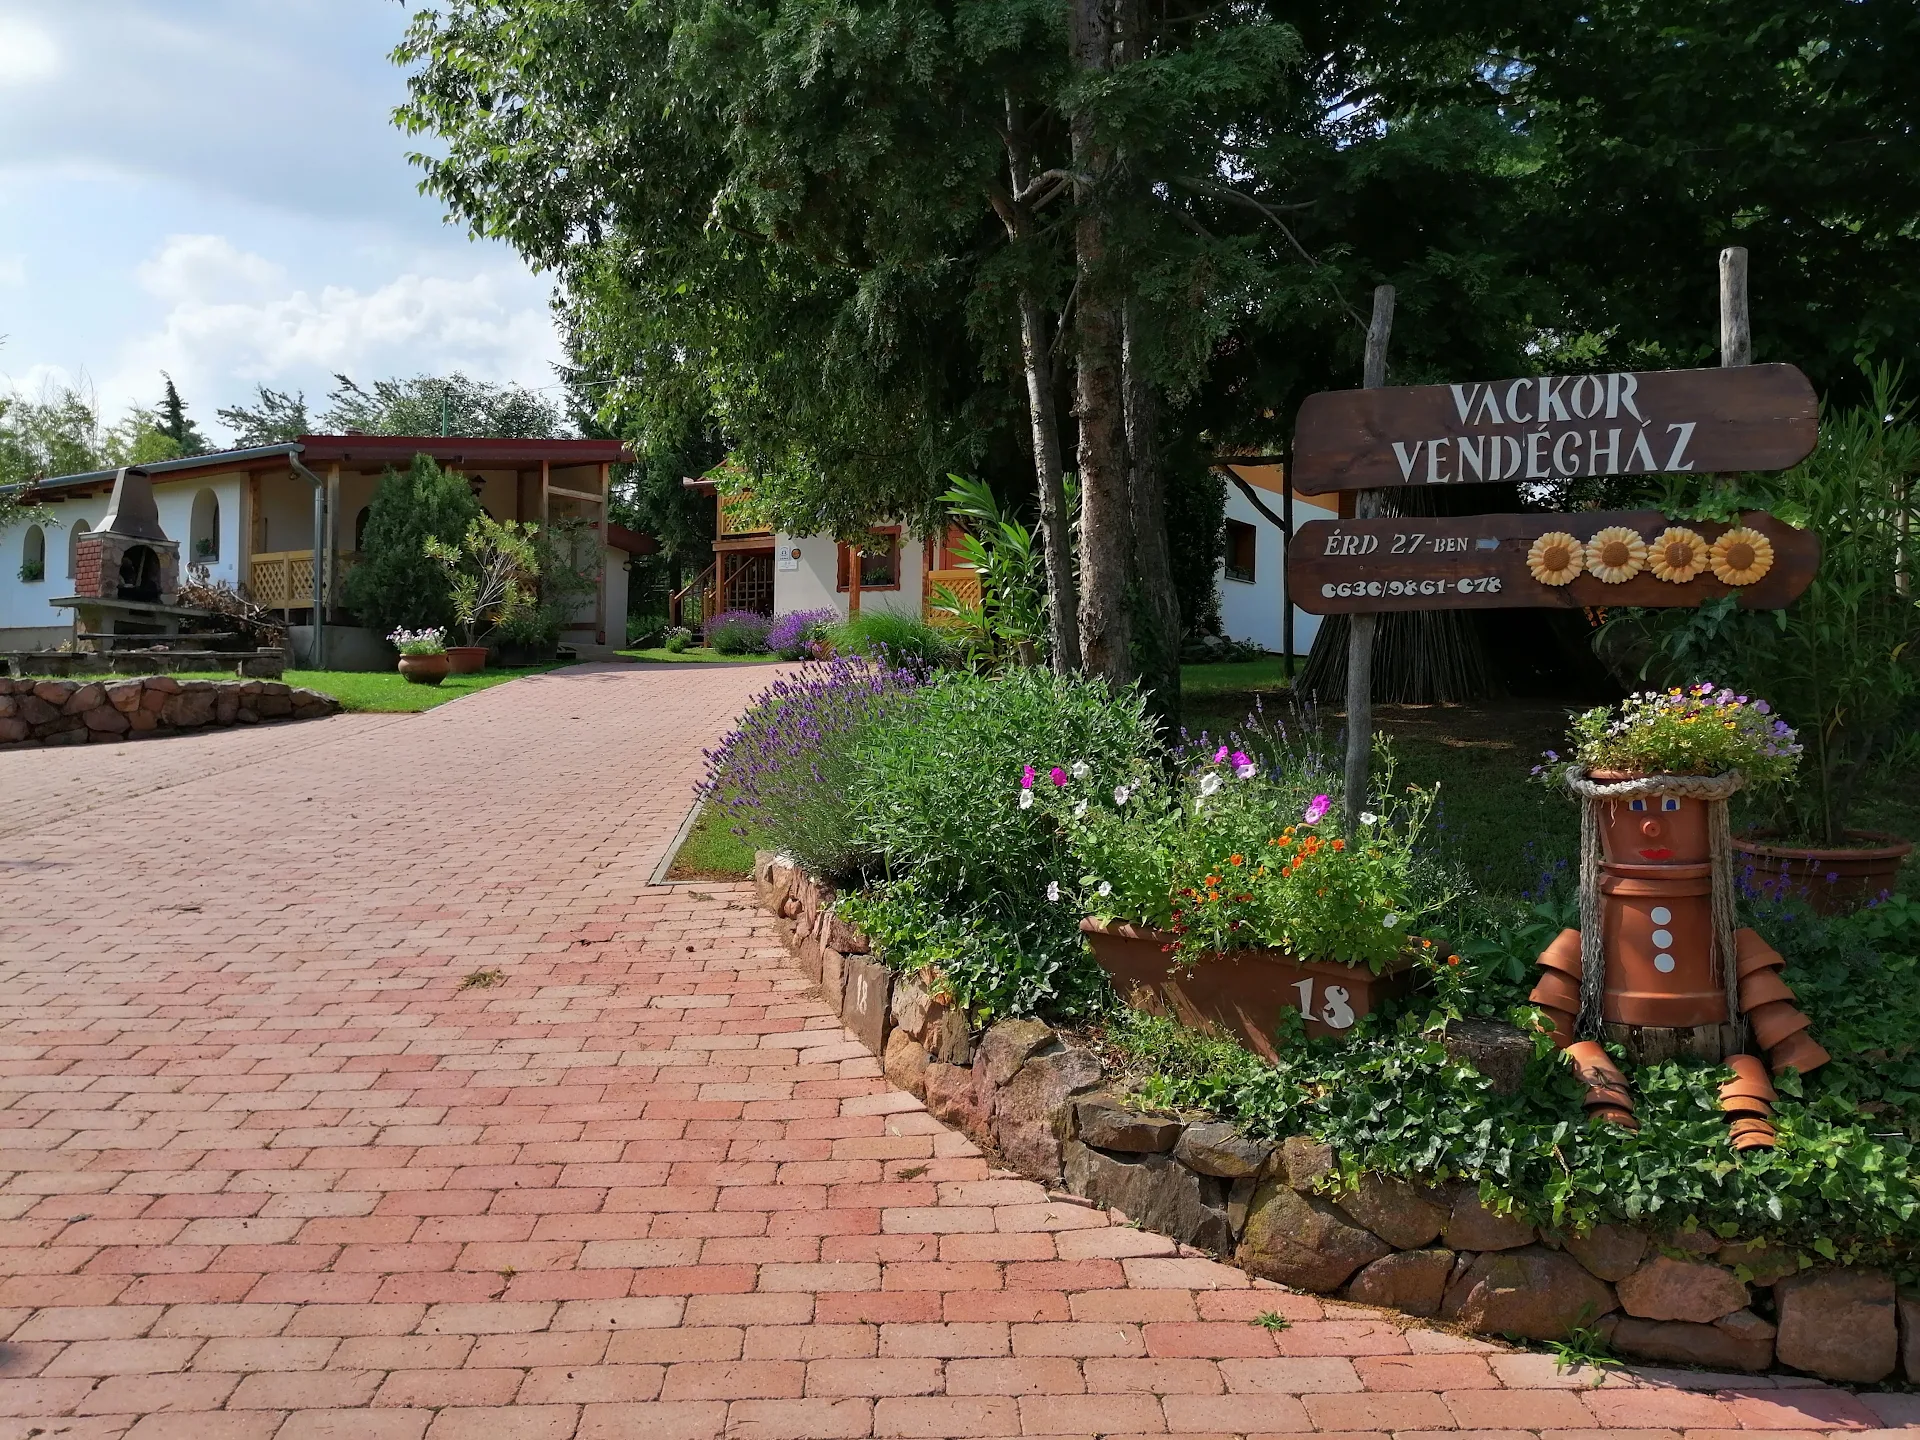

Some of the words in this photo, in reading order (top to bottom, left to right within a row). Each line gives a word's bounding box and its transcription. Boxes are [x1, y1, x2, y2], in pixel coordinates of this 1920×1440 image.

[1450, 373, 1643, 426] VACKOR
[1391, 420, 1697, 483] VENDÉGHÁZ
[1323, 528, 1379, 556] ÉRD
[1390, 533, 1469, 553] 27-BEN
[1290, 977, 1355, 1029] 18
